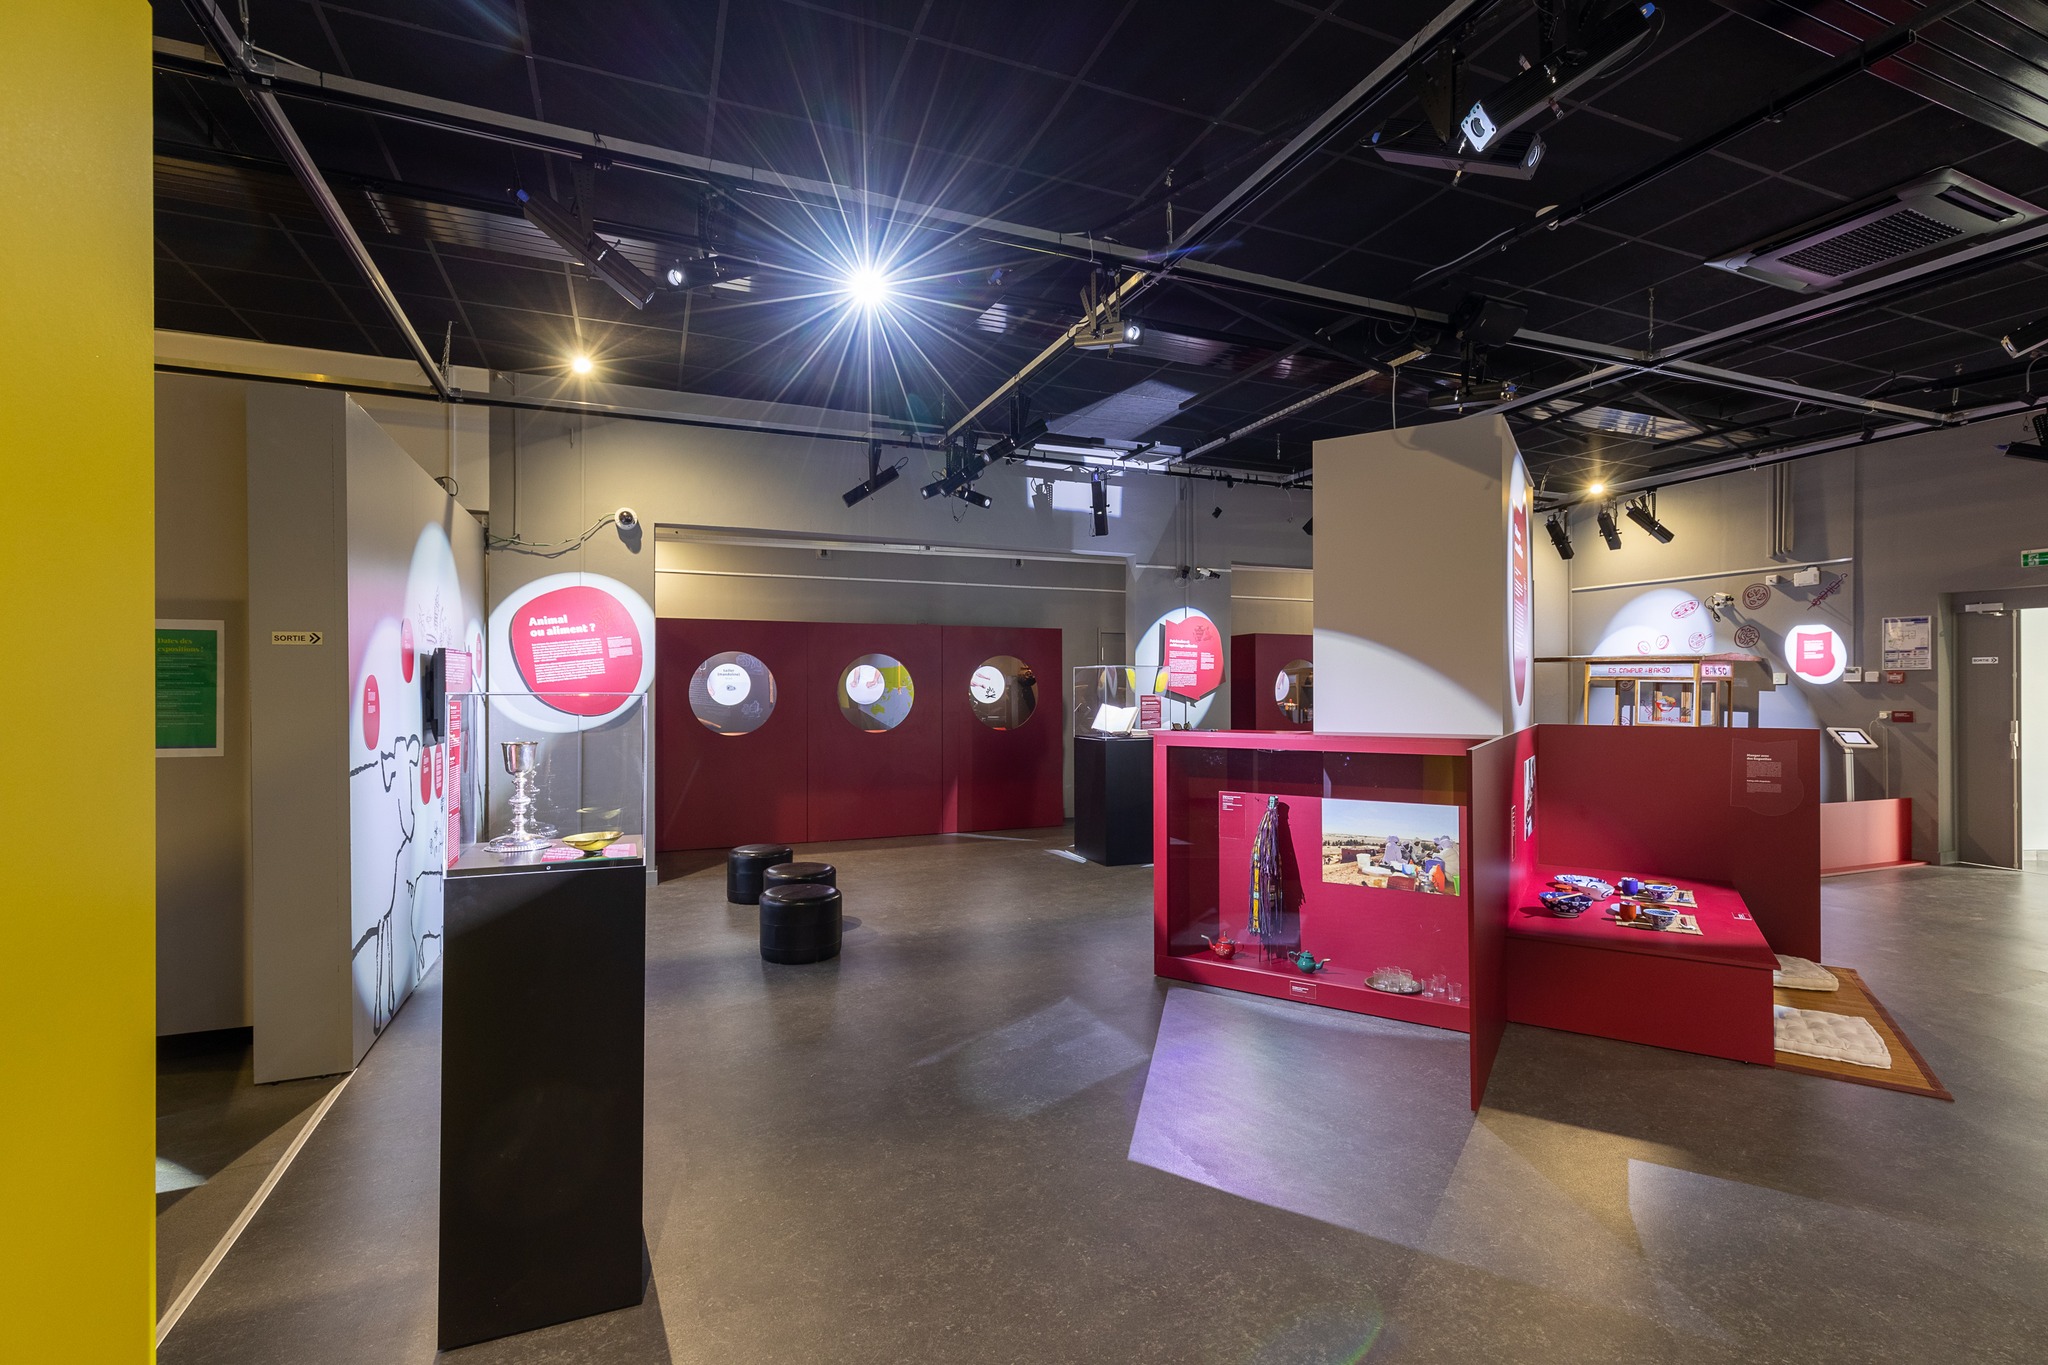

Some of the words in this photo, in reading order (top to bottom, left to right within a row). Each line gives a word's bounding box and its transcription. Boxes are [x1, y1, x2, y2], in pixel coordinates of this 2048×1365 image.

[529, 614, 568, 626] Animal
[530, 629, 545, 637] ou
[546, 624, 588, 636] aliment
[589, 623, 596, 632] ?
[1705, 667, 1727, 676] BAKSO
